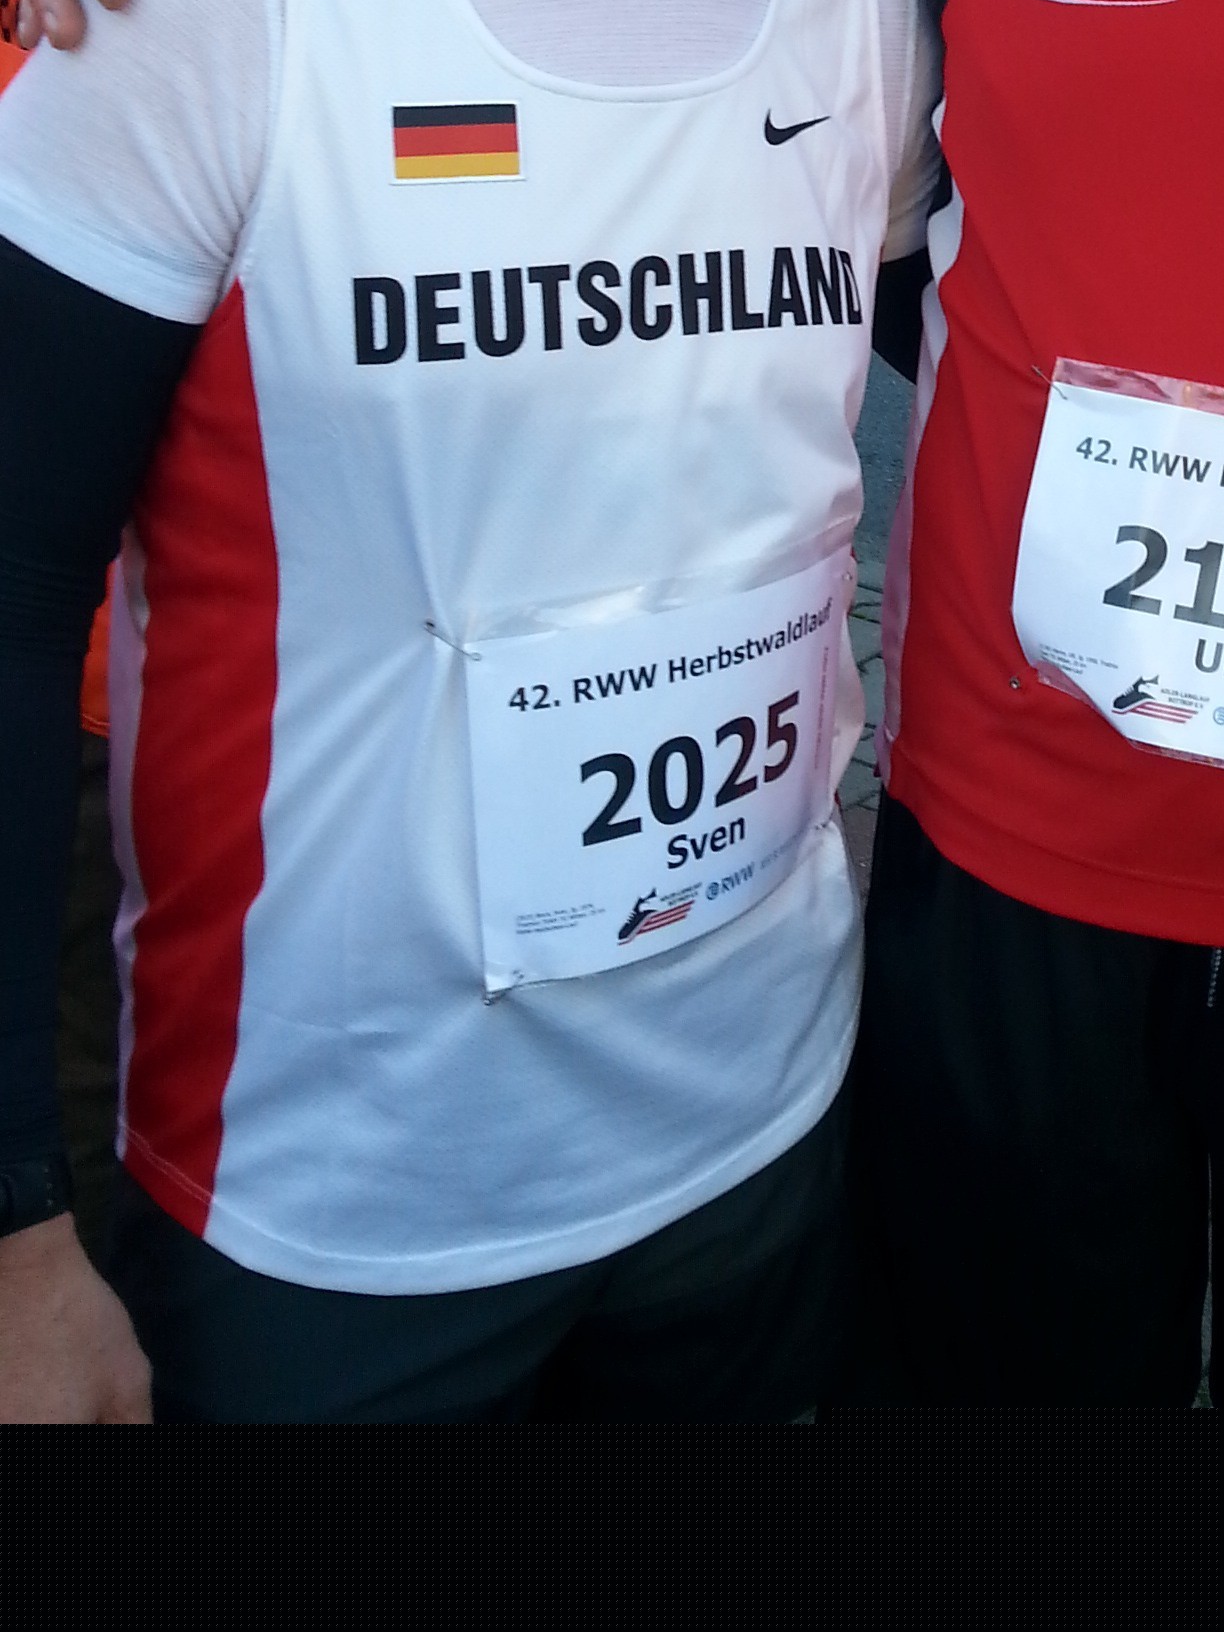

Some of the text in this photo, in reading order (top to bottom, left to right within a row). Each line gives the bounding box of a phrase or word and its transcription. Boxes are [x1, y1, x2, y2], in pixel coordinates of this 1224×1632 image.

[352, 246, 864, 366] DEUTSCHLAND
[1075, 437, 1118, 466] 42.
[1128, 446, 1212, 484] RWW
[508, 597, 834, 712] 42. RWW Herbstwaldlauf
[580, 689, 800, 847] 2025
[666, 816, 746, 869] Sven
